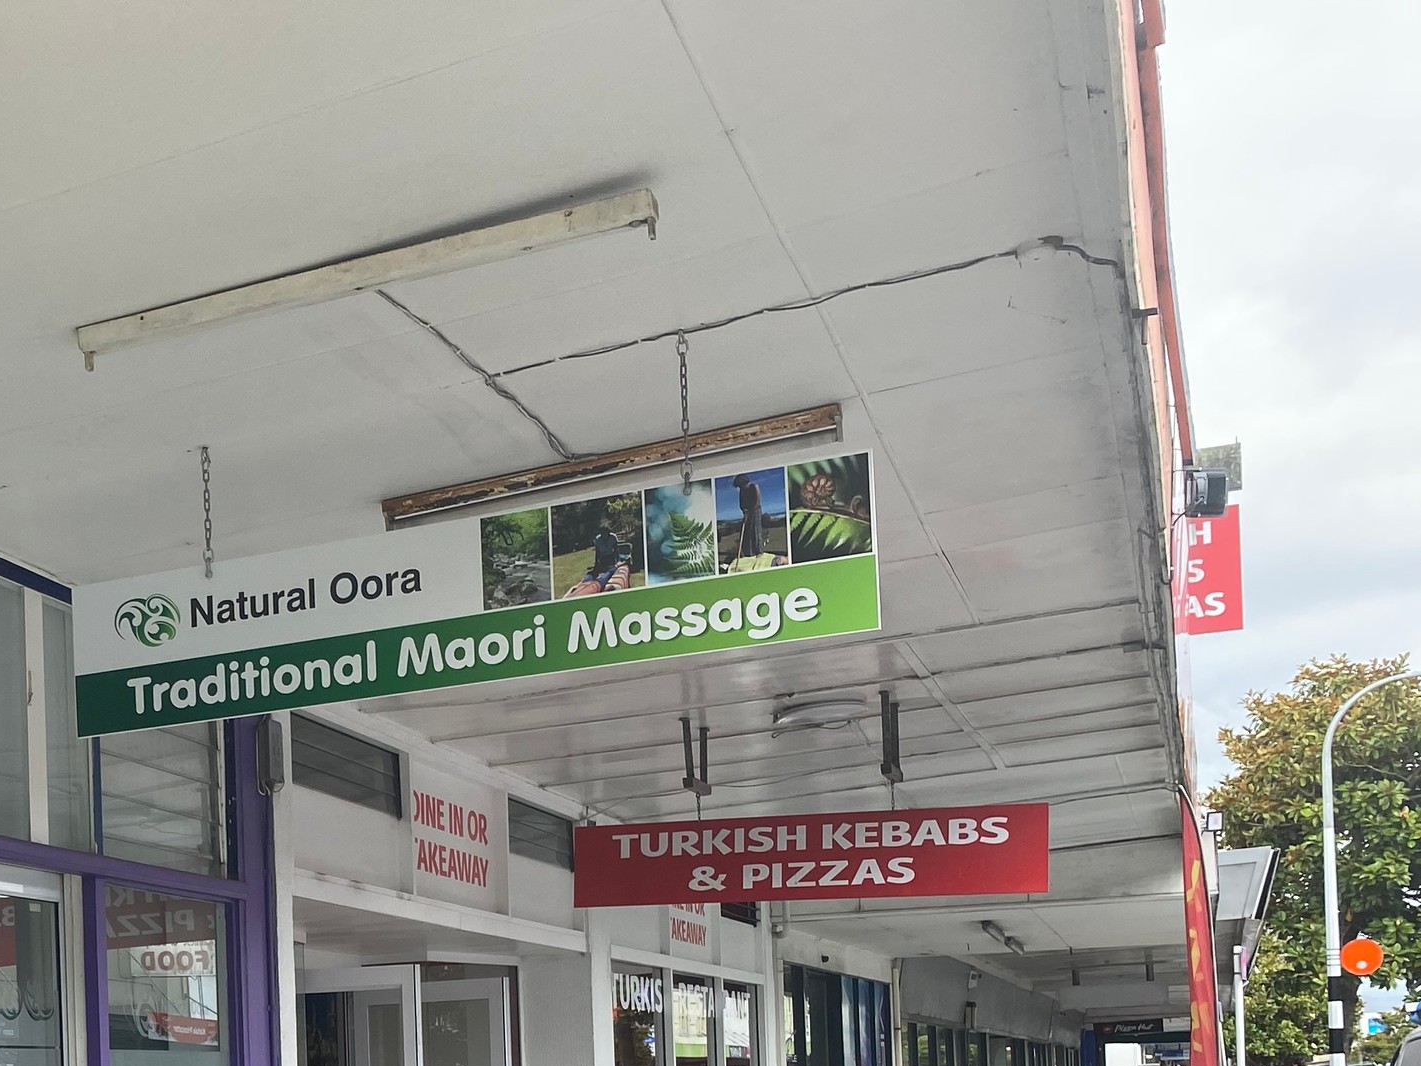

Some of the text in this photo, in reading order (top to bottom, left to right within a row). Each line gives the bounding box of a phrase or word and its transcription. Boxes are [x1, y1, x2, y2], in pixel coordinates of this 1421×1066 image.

[190, 563, 422, 628] Natural Oora
[127, 585, 819, 716] Traditional Maori Massage
[449, 803, 464, 837] IN
[468, 810, 488, 846] OR
[612, 817, 1010, 859] TURKISH KEBABS
[415, 837, 488, 888] AKEAWAY
[688, 857, 916, 892] & PIZZAS
[670, 917, 706, 946] AKEAWAY
